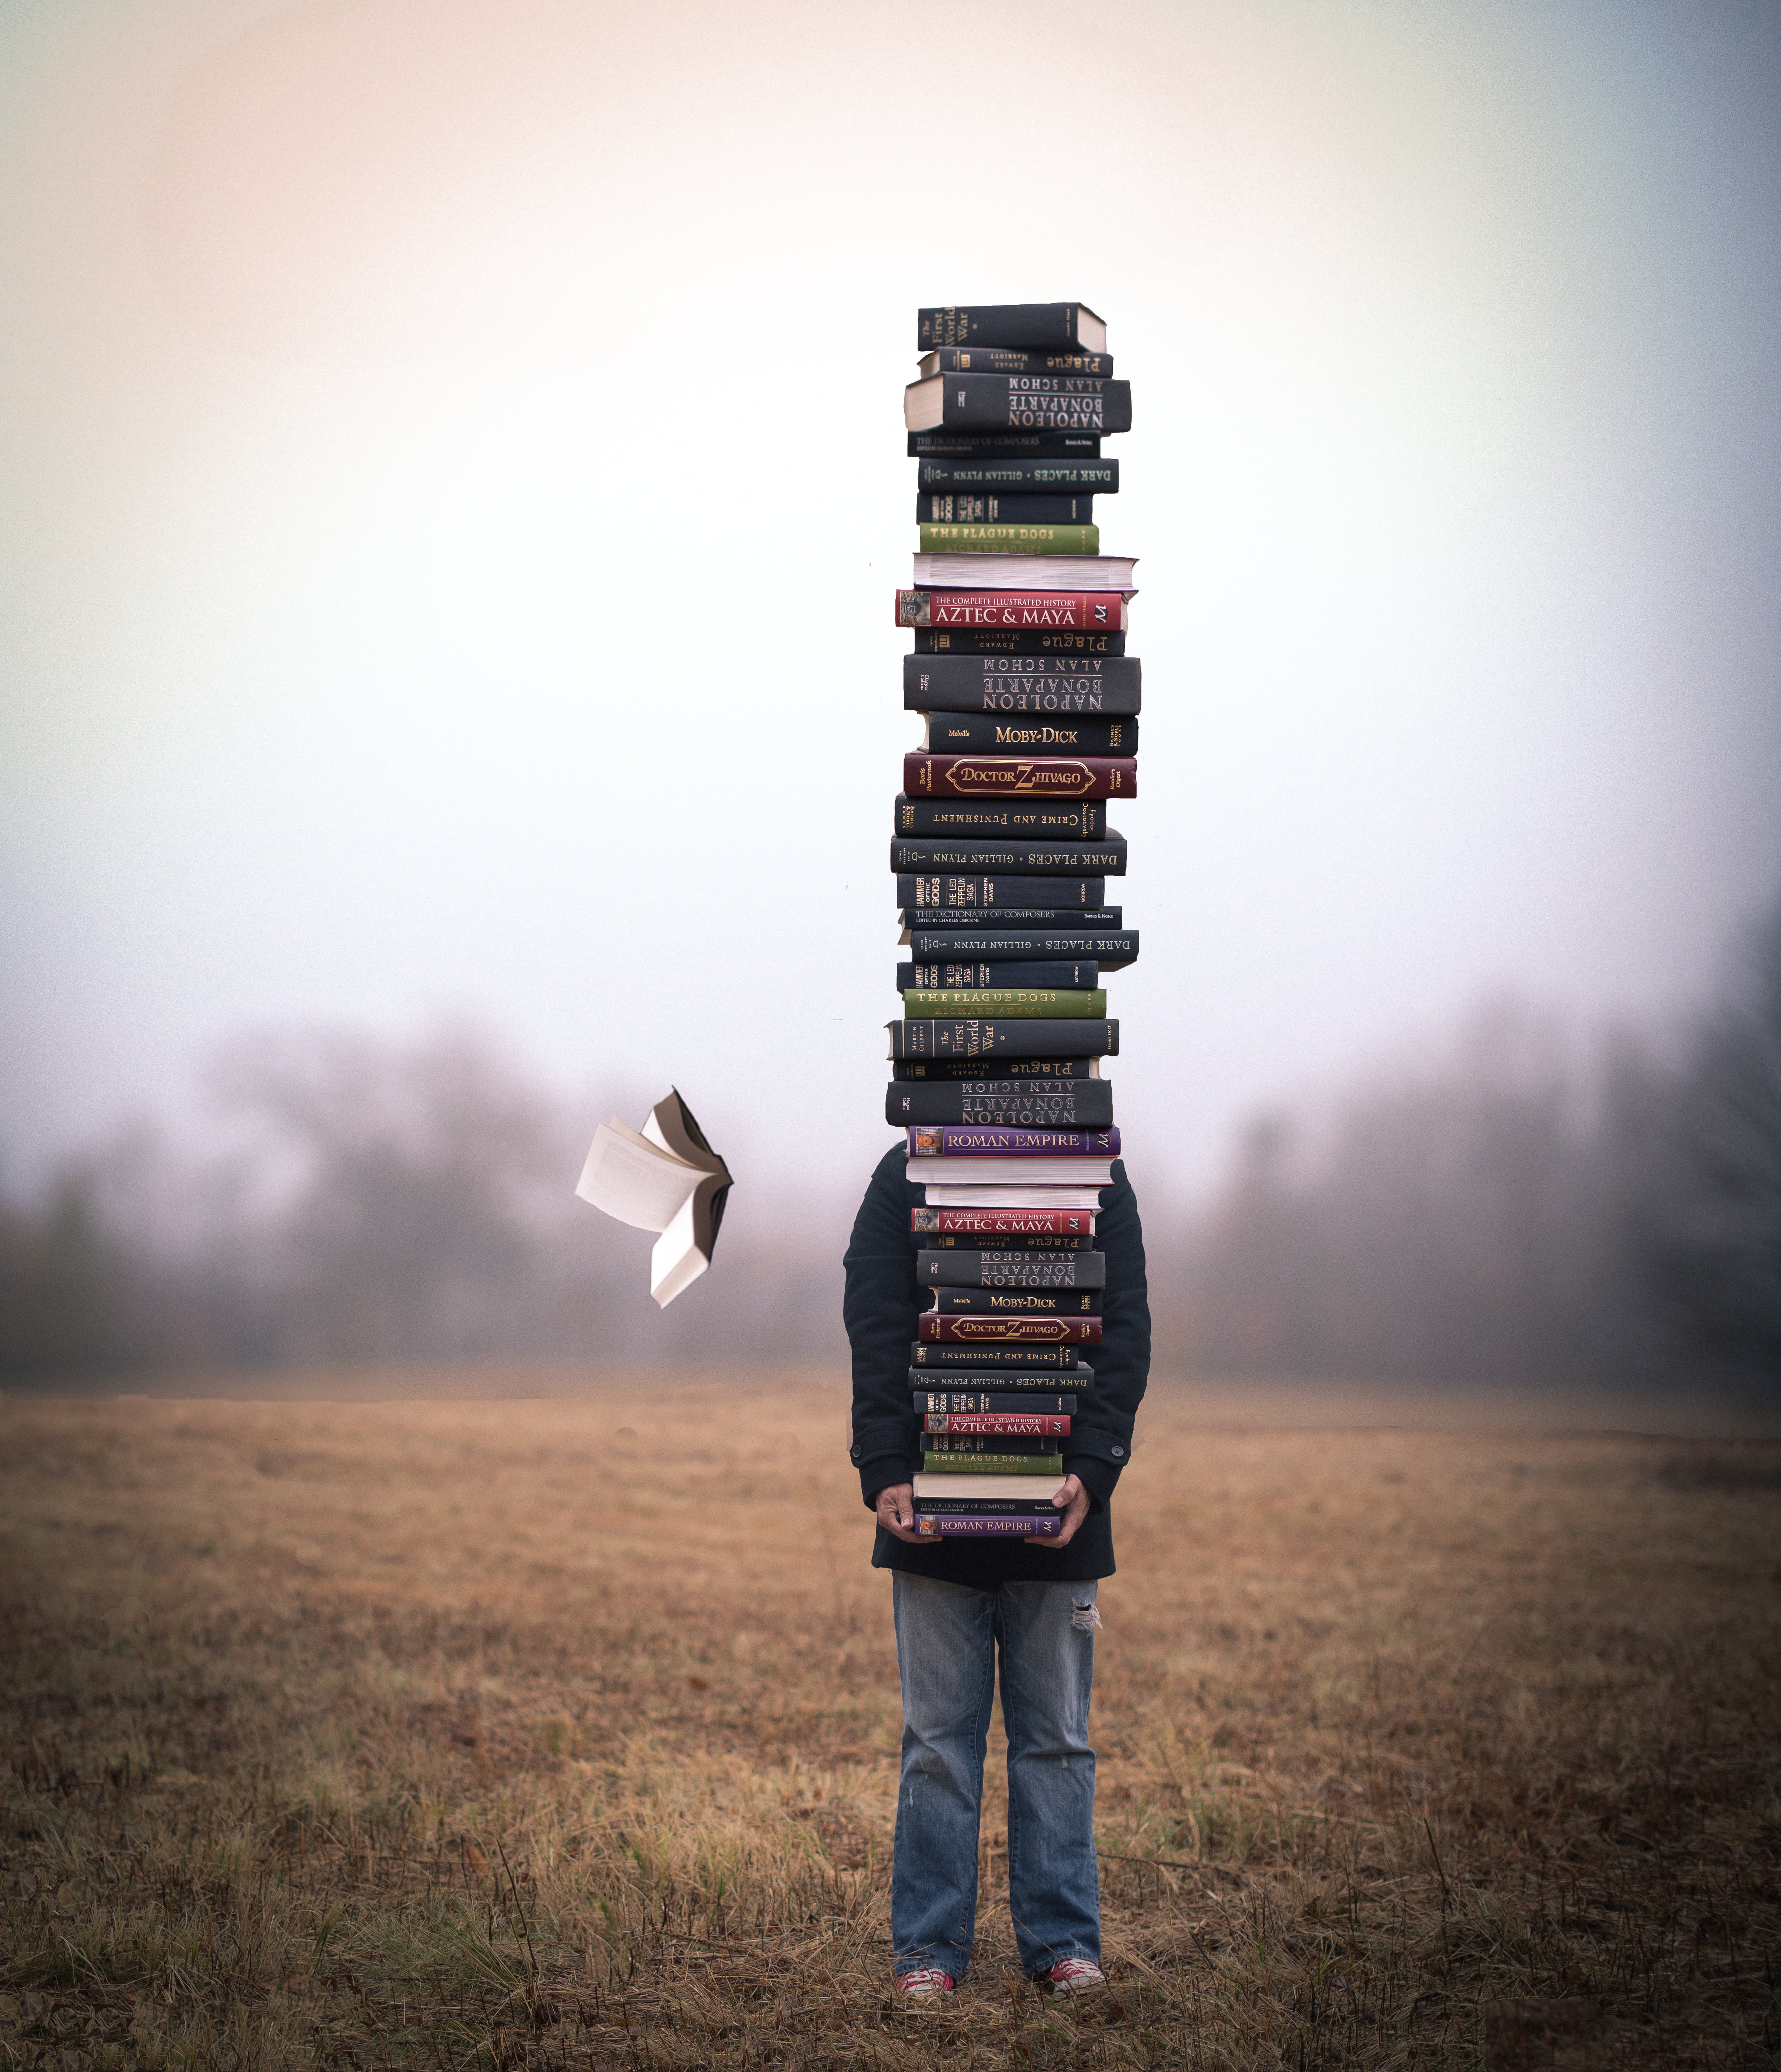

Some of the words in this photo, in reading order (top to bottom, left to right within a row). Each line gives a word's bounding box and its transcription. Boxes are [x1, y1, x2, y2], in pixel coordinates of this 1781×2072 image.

[933, 313, 942, 342] First
[958, 313, 967, 340] War
[1047, 356, 1100, 372] Plague
[1010, 378, 1057, 390] SCHOM
[1066, 380, 1102, 391] ALAN
[1009, 396, 1102, 412] BONAPARTE
[1009, 411, 1103, 427] NAPOLEON
[986, 472, 1022, 480] GILLIAN
[1035, 470, 1077, 480] PLACES
[1081, 470, 1111, 481] DARK
[931, 528, 957, 537] THE
[963, 528, 1014, 537] PLAGUE
[1020, 529, 1053, 539] DOGS
[937, 607, 996, 622] AZTEC
[1003, 609, 1017, 623] &
[1022, 609, 1074, 624] MAYA
[1043, 633, 1107, 651] Plague
[984, 660, 1044, 670] SCHOM
[1056, 660, 1102, 671] ALAN
[984, 679, 1102, 693] BONAPARTE
[983, 694, 1102, 710] NAPOLEON
[971, 855, 1013, 863] GILLIAN
[1029, 854, 1077, 864] PLACES
[1082, 855, 1117, 865] DARK
[1097, 941, 1130, 949] DARK
[954, 993, 1012, 1001] PLAGUE
[953, 1025, 963, 1052] First
[967, 1020, 979, 1056] World
[983, 1026, 993, 1050] War
[1011, 1062, 1072, 1075] Plague
[962, 1083, 1019, 1092] SCHOM
[1030, 1082, 1074, 1091] ALAN
[962, 1098, 1074, 1111] BONAPARTE
[962, 1111, 1076, 1124] NAPOLEON
[948, 1136, 1009, 1146] ROMAN
[1015, 1135, 1079, 1146] EMPIRE
[944, 1220, 991, 1229] AZTEC
[996, 1221, 1008, 1230] &
[1012, 1221, 1053, 1230] MAYA
[1028, 1236, 1079, 1247] Plague
[982, 1266, 1074, 1275] BONAPARTE
[981, 1276, 1075, 1286] NAPOLEON
[951, 1423, 990, 1431] AZTEC
[1007, 1424, 1041, 1432] MAYA
